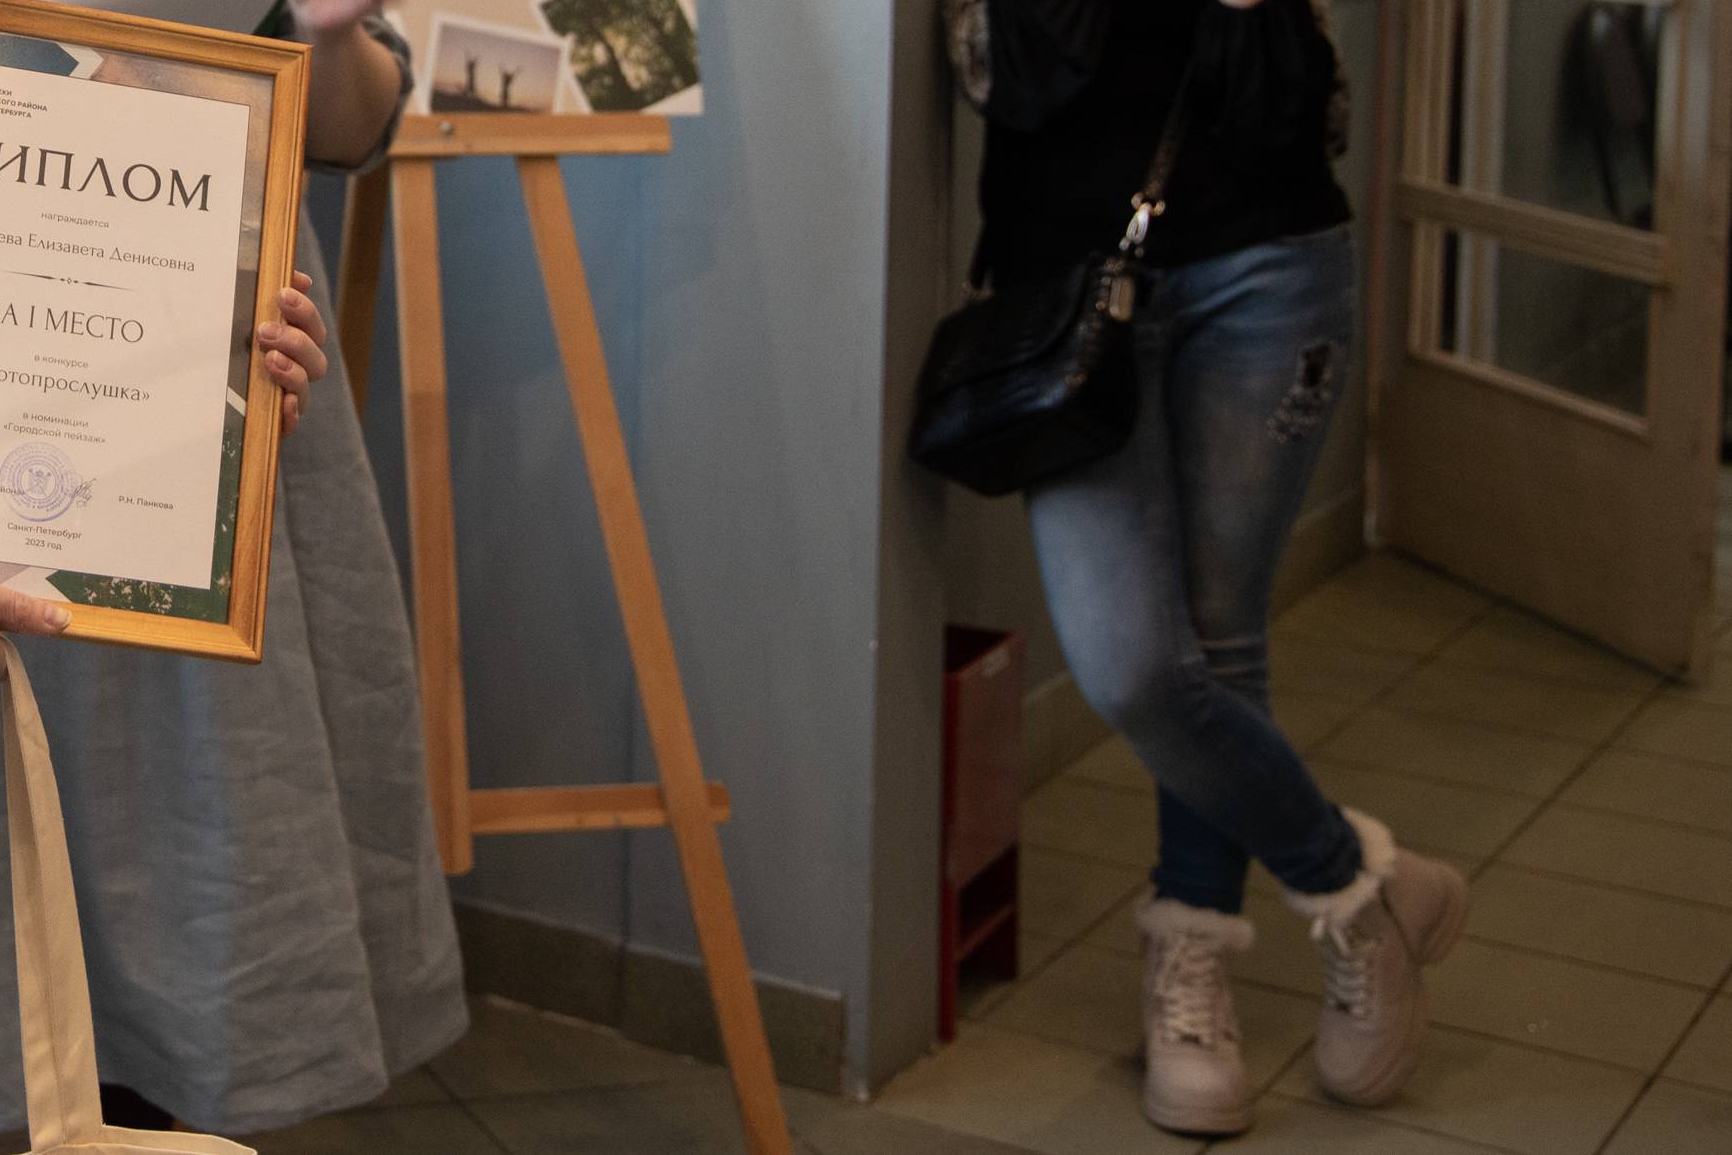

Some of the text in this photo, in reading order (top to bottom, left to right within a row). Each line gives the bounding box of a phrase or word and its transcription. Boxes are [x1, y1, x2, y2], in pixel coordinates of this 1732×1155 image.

[17, 101, 48, 112] РАЙОНА
[40, 212, 110, 229] награждается
[28, 232, 105, 259] Елизавета
[109, 247, 196, 272] Денисовна
[29, 305, 35, 328] I
[45, 308, 144, 343] МЕСТО
[34, 354, 89, 369] в конкурсе
[23, 412, 90, 428] в номинации
[3, 422, 106, 444] «Городской пейзаж»
[118, 495, 174, 510] Р.Н. Панкова
[7, 522, 83, 540] Санкт-Петербург
[25, 537, 62, 551] 2023 год
